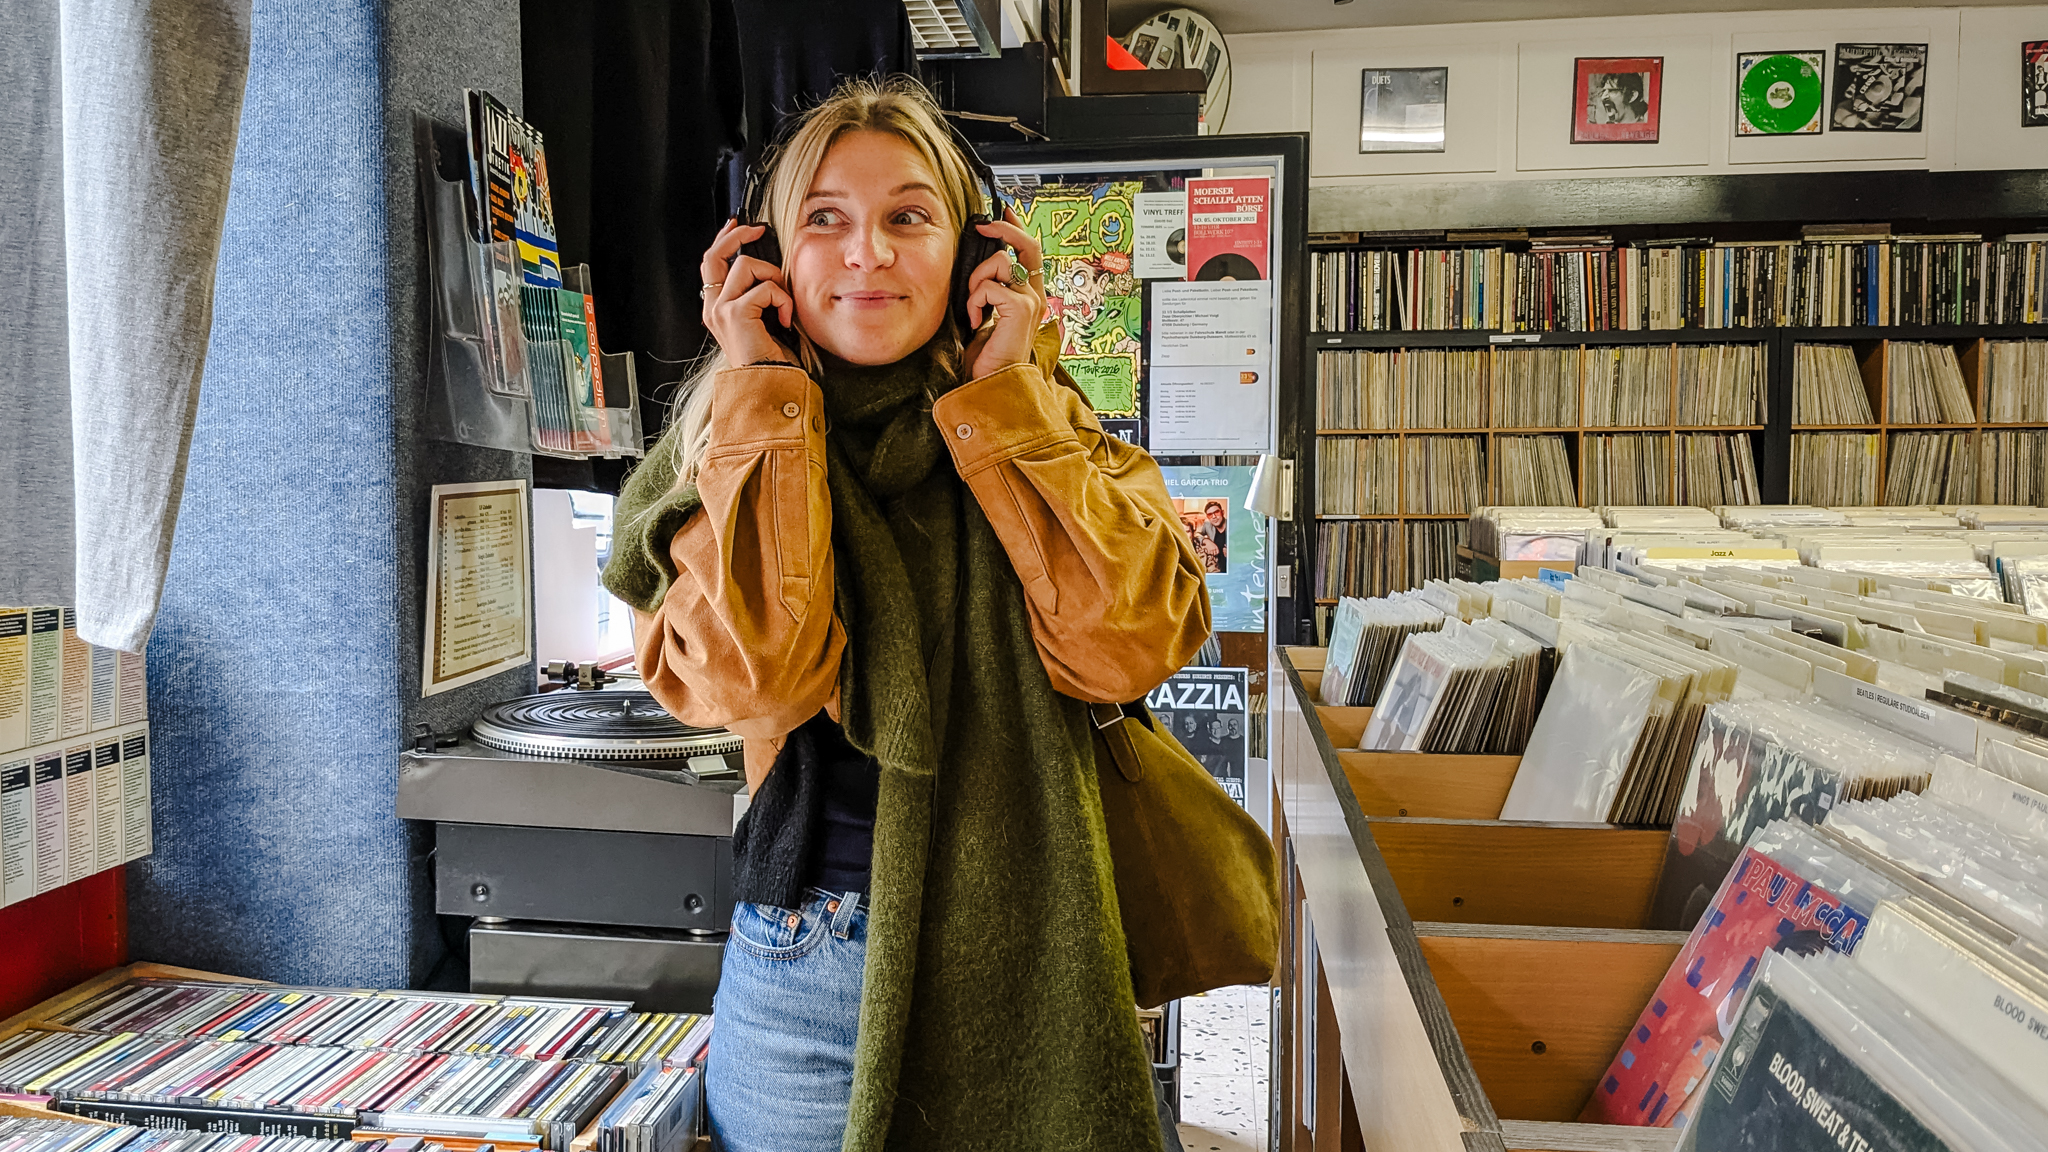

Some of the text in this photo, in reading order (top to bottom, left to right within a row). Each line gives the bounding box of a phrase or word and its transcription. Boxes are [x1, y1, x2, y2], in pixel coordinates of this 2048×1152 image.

[1371, 75, 1391, 84] DUETS
[1193, 187, 1234, 196] MOERSER
[1193, 195, 1264, 205] SCHALLPLATTEN
[1143, 208, 1185, 216] VINYL TREFF
[1236, 204, 1264, 213] BÖRSE
[588, 321, 607, 429] carpediem
[1100, 364, 1120, 375] 2026
[1164, 478, 1179, 486] NIEL
[1210, 478, 1229, 486] TRIO
[1856, 687, 1875, 700] BEATLES
[1877, 694, 1900, 710] REGULÄRE
[2012, 790, 2030, 807] WINGS
[1743, 858, 1798, 914] PAUL
[1993, 994, 2048, 1041] BLOOD SWE
[1768, 1051, 1806, 1107] BLOOD,
[1802, 1086, 1845, 1138] SWEAT
[1837, 1123, 1851, 1149] &
